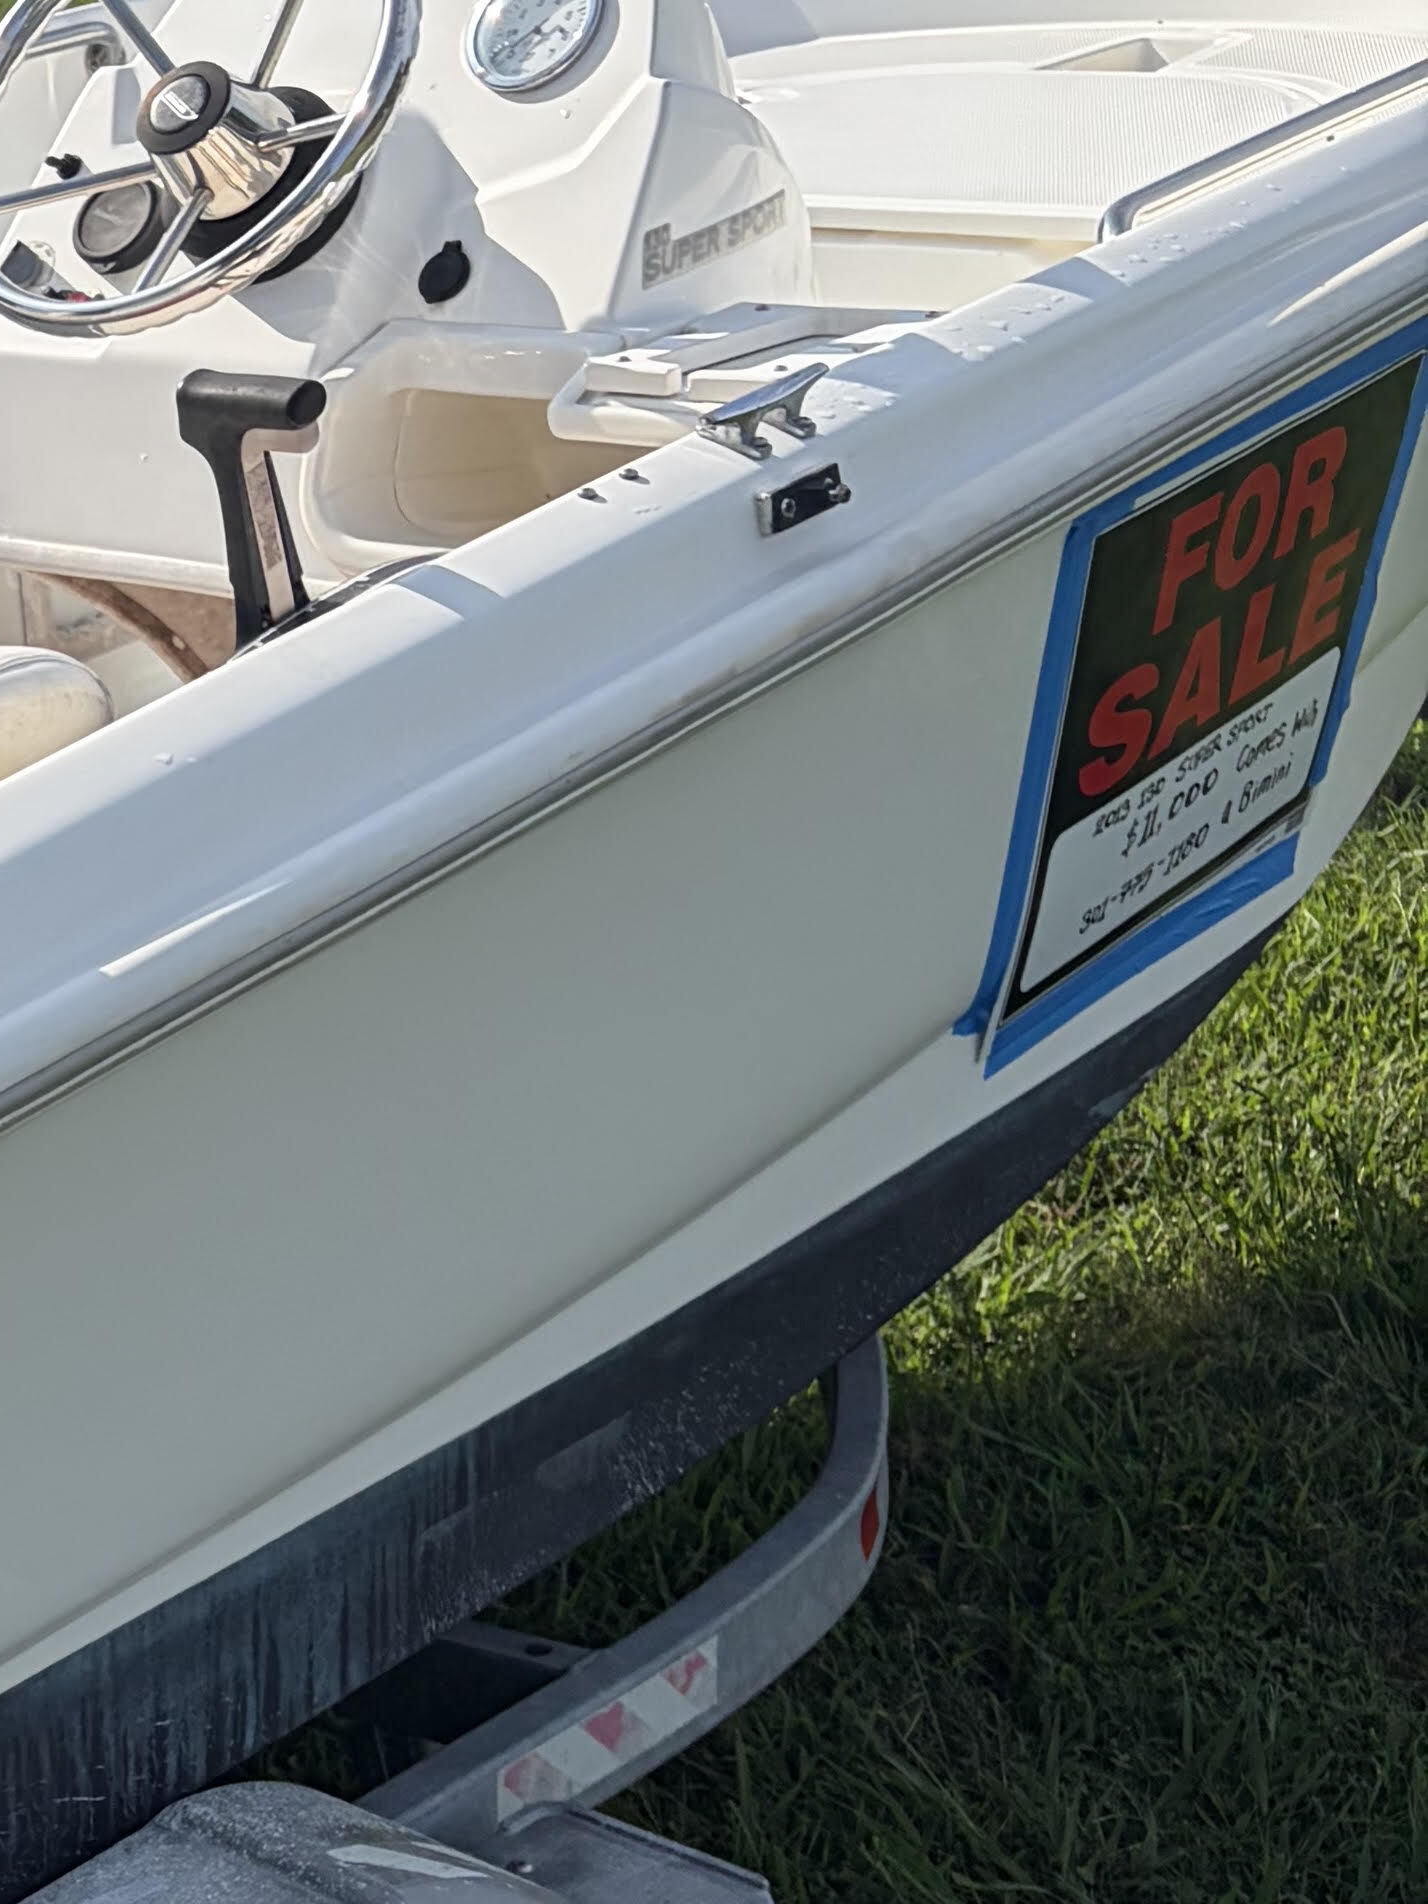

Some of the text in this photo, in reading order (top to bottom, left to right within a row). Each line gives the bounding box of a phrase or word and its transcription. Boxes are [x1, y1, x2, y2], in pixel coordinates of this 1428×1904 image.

[644, 226, 721, 282] SUPER
[727, 192, 785, 248] SPORT
[1151, 426, 1347, 636] FOR
[1078, 527, 1362, 797] SALE
